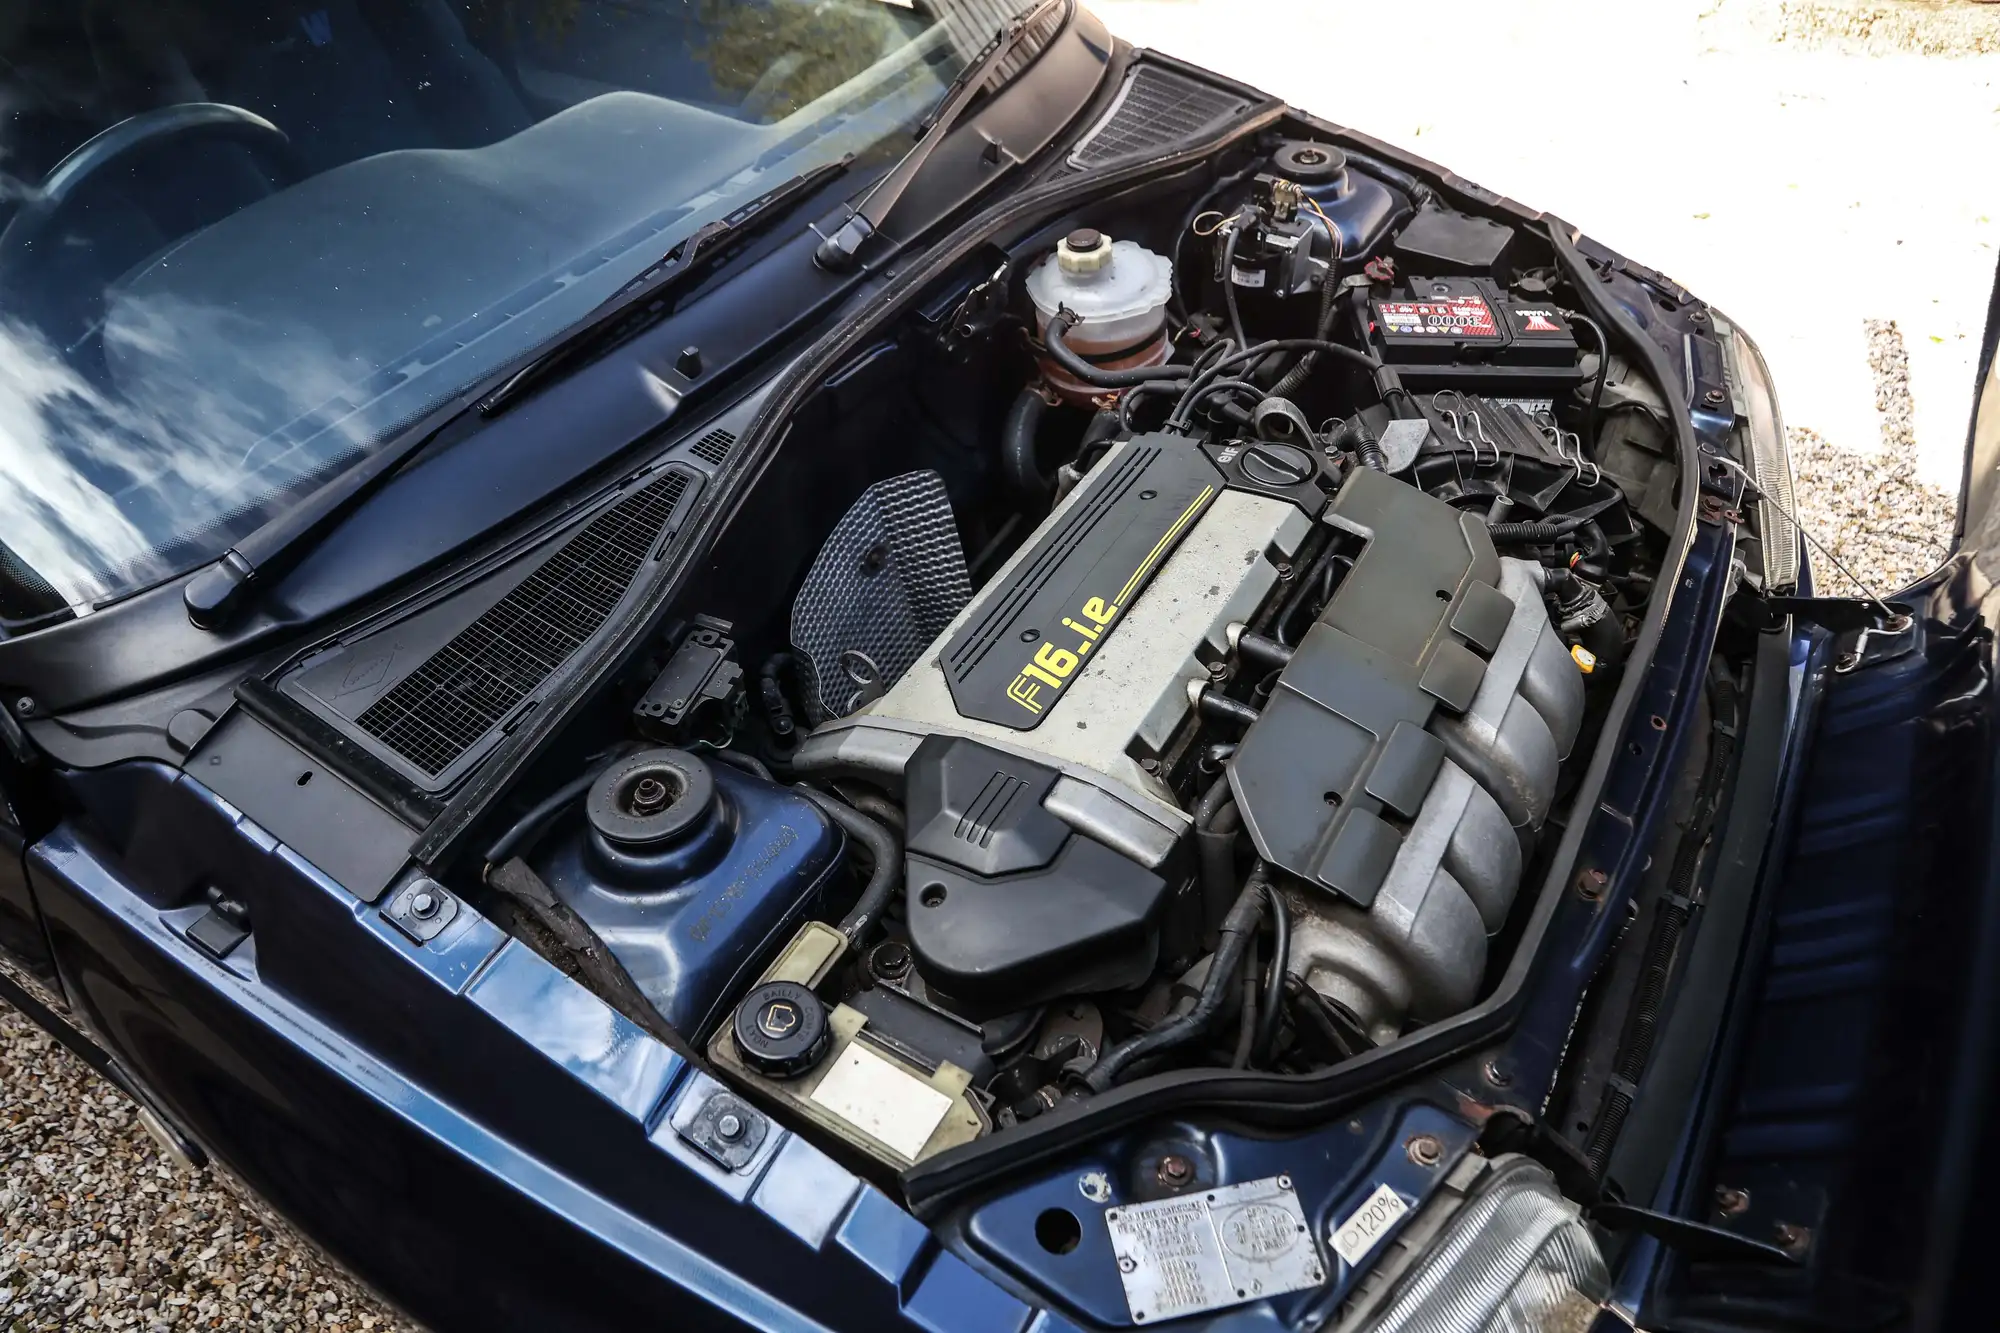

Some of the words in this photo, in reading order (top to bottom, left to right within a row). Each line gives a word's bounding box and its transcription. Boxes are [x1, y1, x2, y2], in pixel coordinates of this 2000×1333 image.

[1515, 309, 1552, 317] YUASA
[1427, 314, 1482, 327] 3000
[1217, 446, 1239, 464] elf
[763, 989, 803, 1001] BAILLY
